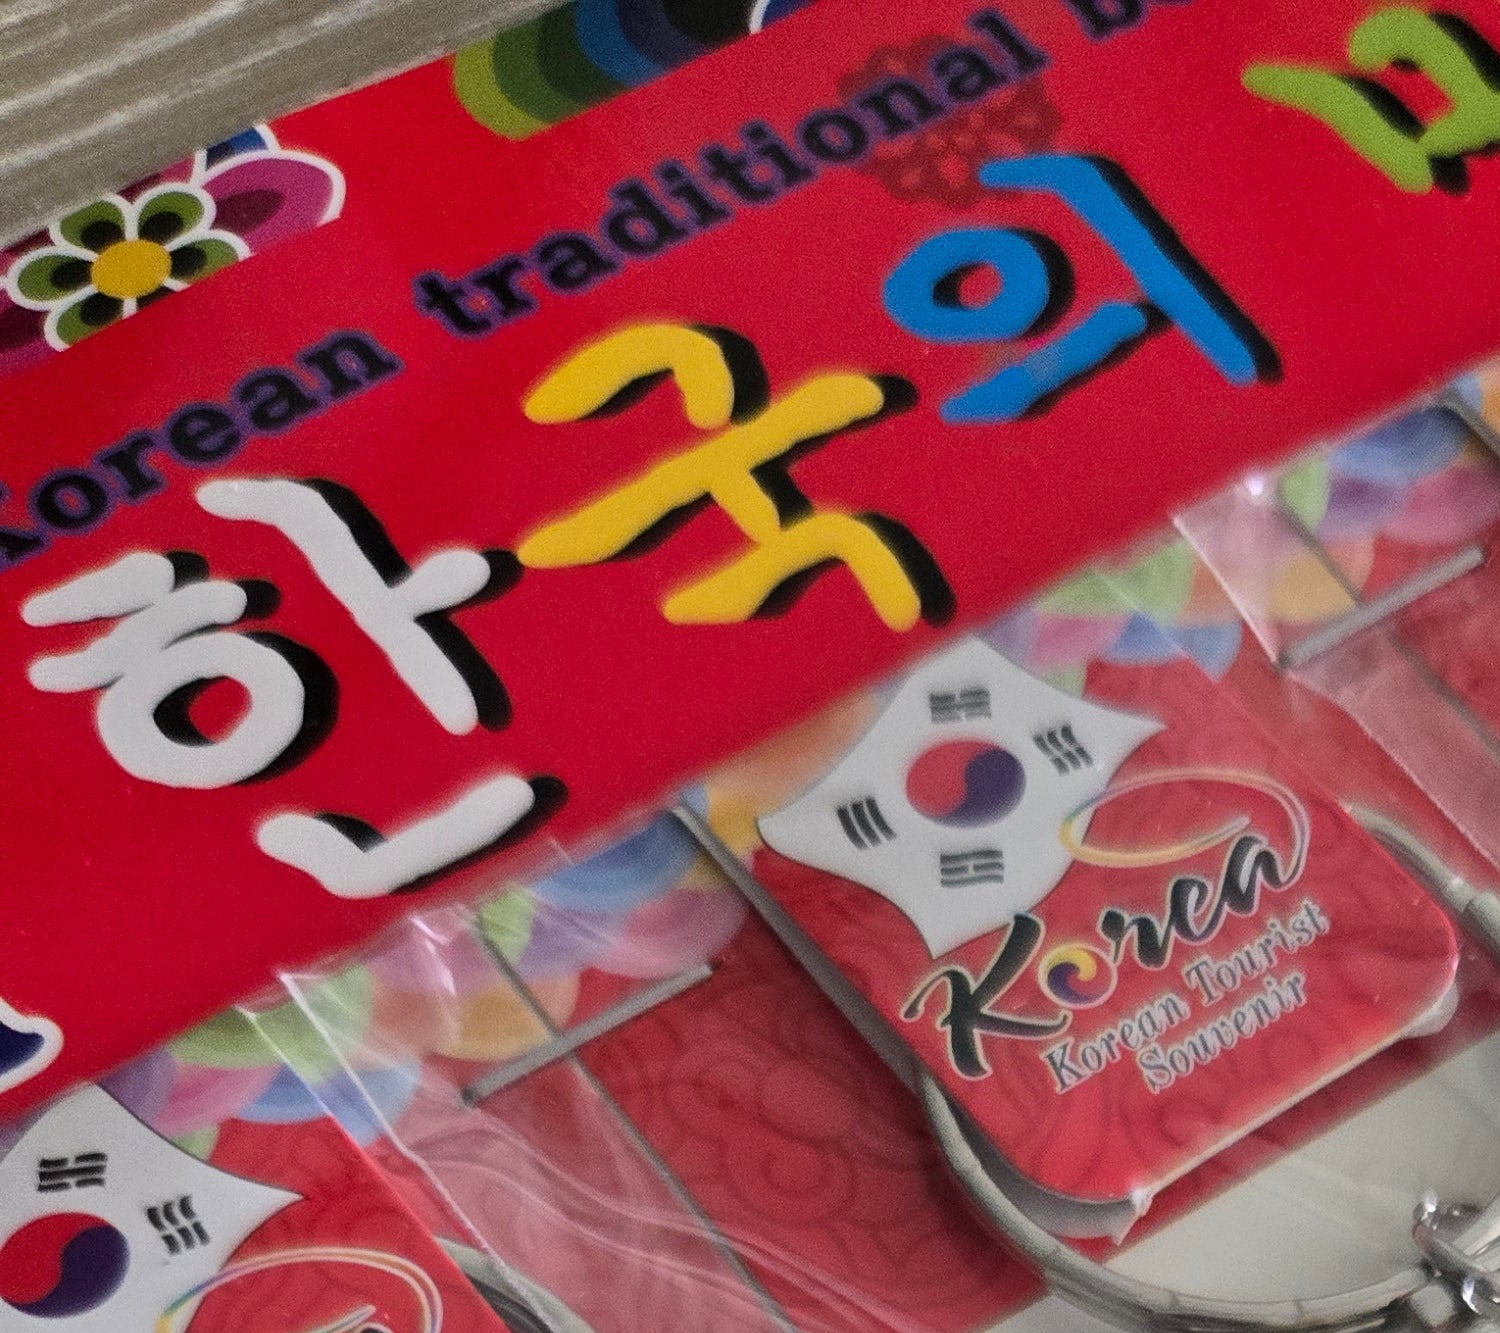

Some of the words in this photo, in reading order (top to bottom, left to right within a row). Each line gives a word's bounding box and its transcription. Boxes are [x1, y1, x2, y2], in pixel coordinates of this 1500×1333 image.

[412, 5, 1053, 341] traditional
[900, 833, 1306, 1081] Korea
[1042, 991, 1189, 1095] Korean
[1184, 898, 1331, 1011] Tourist
[1136, 969, 1309, 1095] Souvenir
